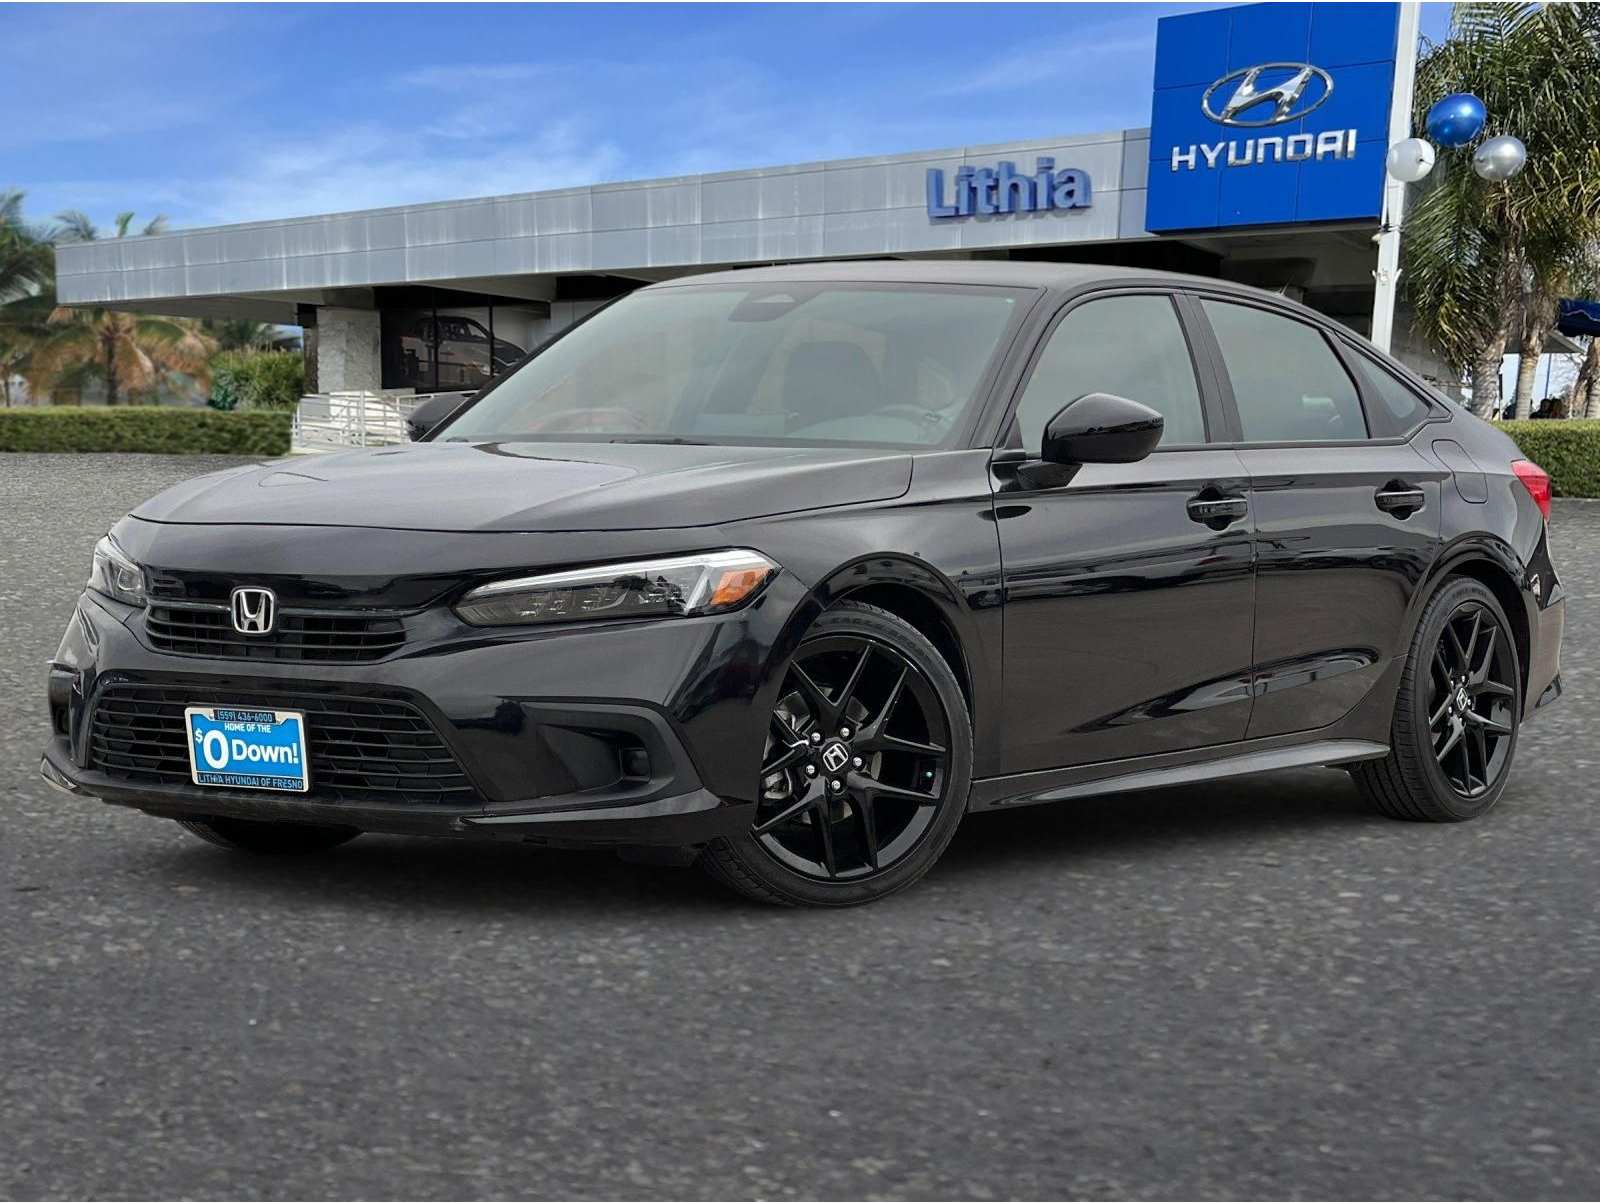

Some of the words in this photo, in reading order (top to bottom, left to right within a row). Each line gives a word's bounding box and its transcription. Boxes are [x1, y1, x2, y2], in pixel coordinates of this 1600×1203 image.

[1171, 129, 1357, 172] HYUNDAI
[927, 156, 1092, 219] Lithia
[217, 710, 236, 720] (559)
[237, 711, 273, 722] 436-6000
[224, 722, 245, 732] HOME
[246, 723, 256, 732] OF
[257, 724, 272, 734] THE
[231, 739, 299, 764] Down!
[198, 774, 224, 783] LITHIA
[224, 775, 260, 785] HYUNDAI
[261, 777, 270, 786] OF
[272, 778, 303, 789] FRESNO
